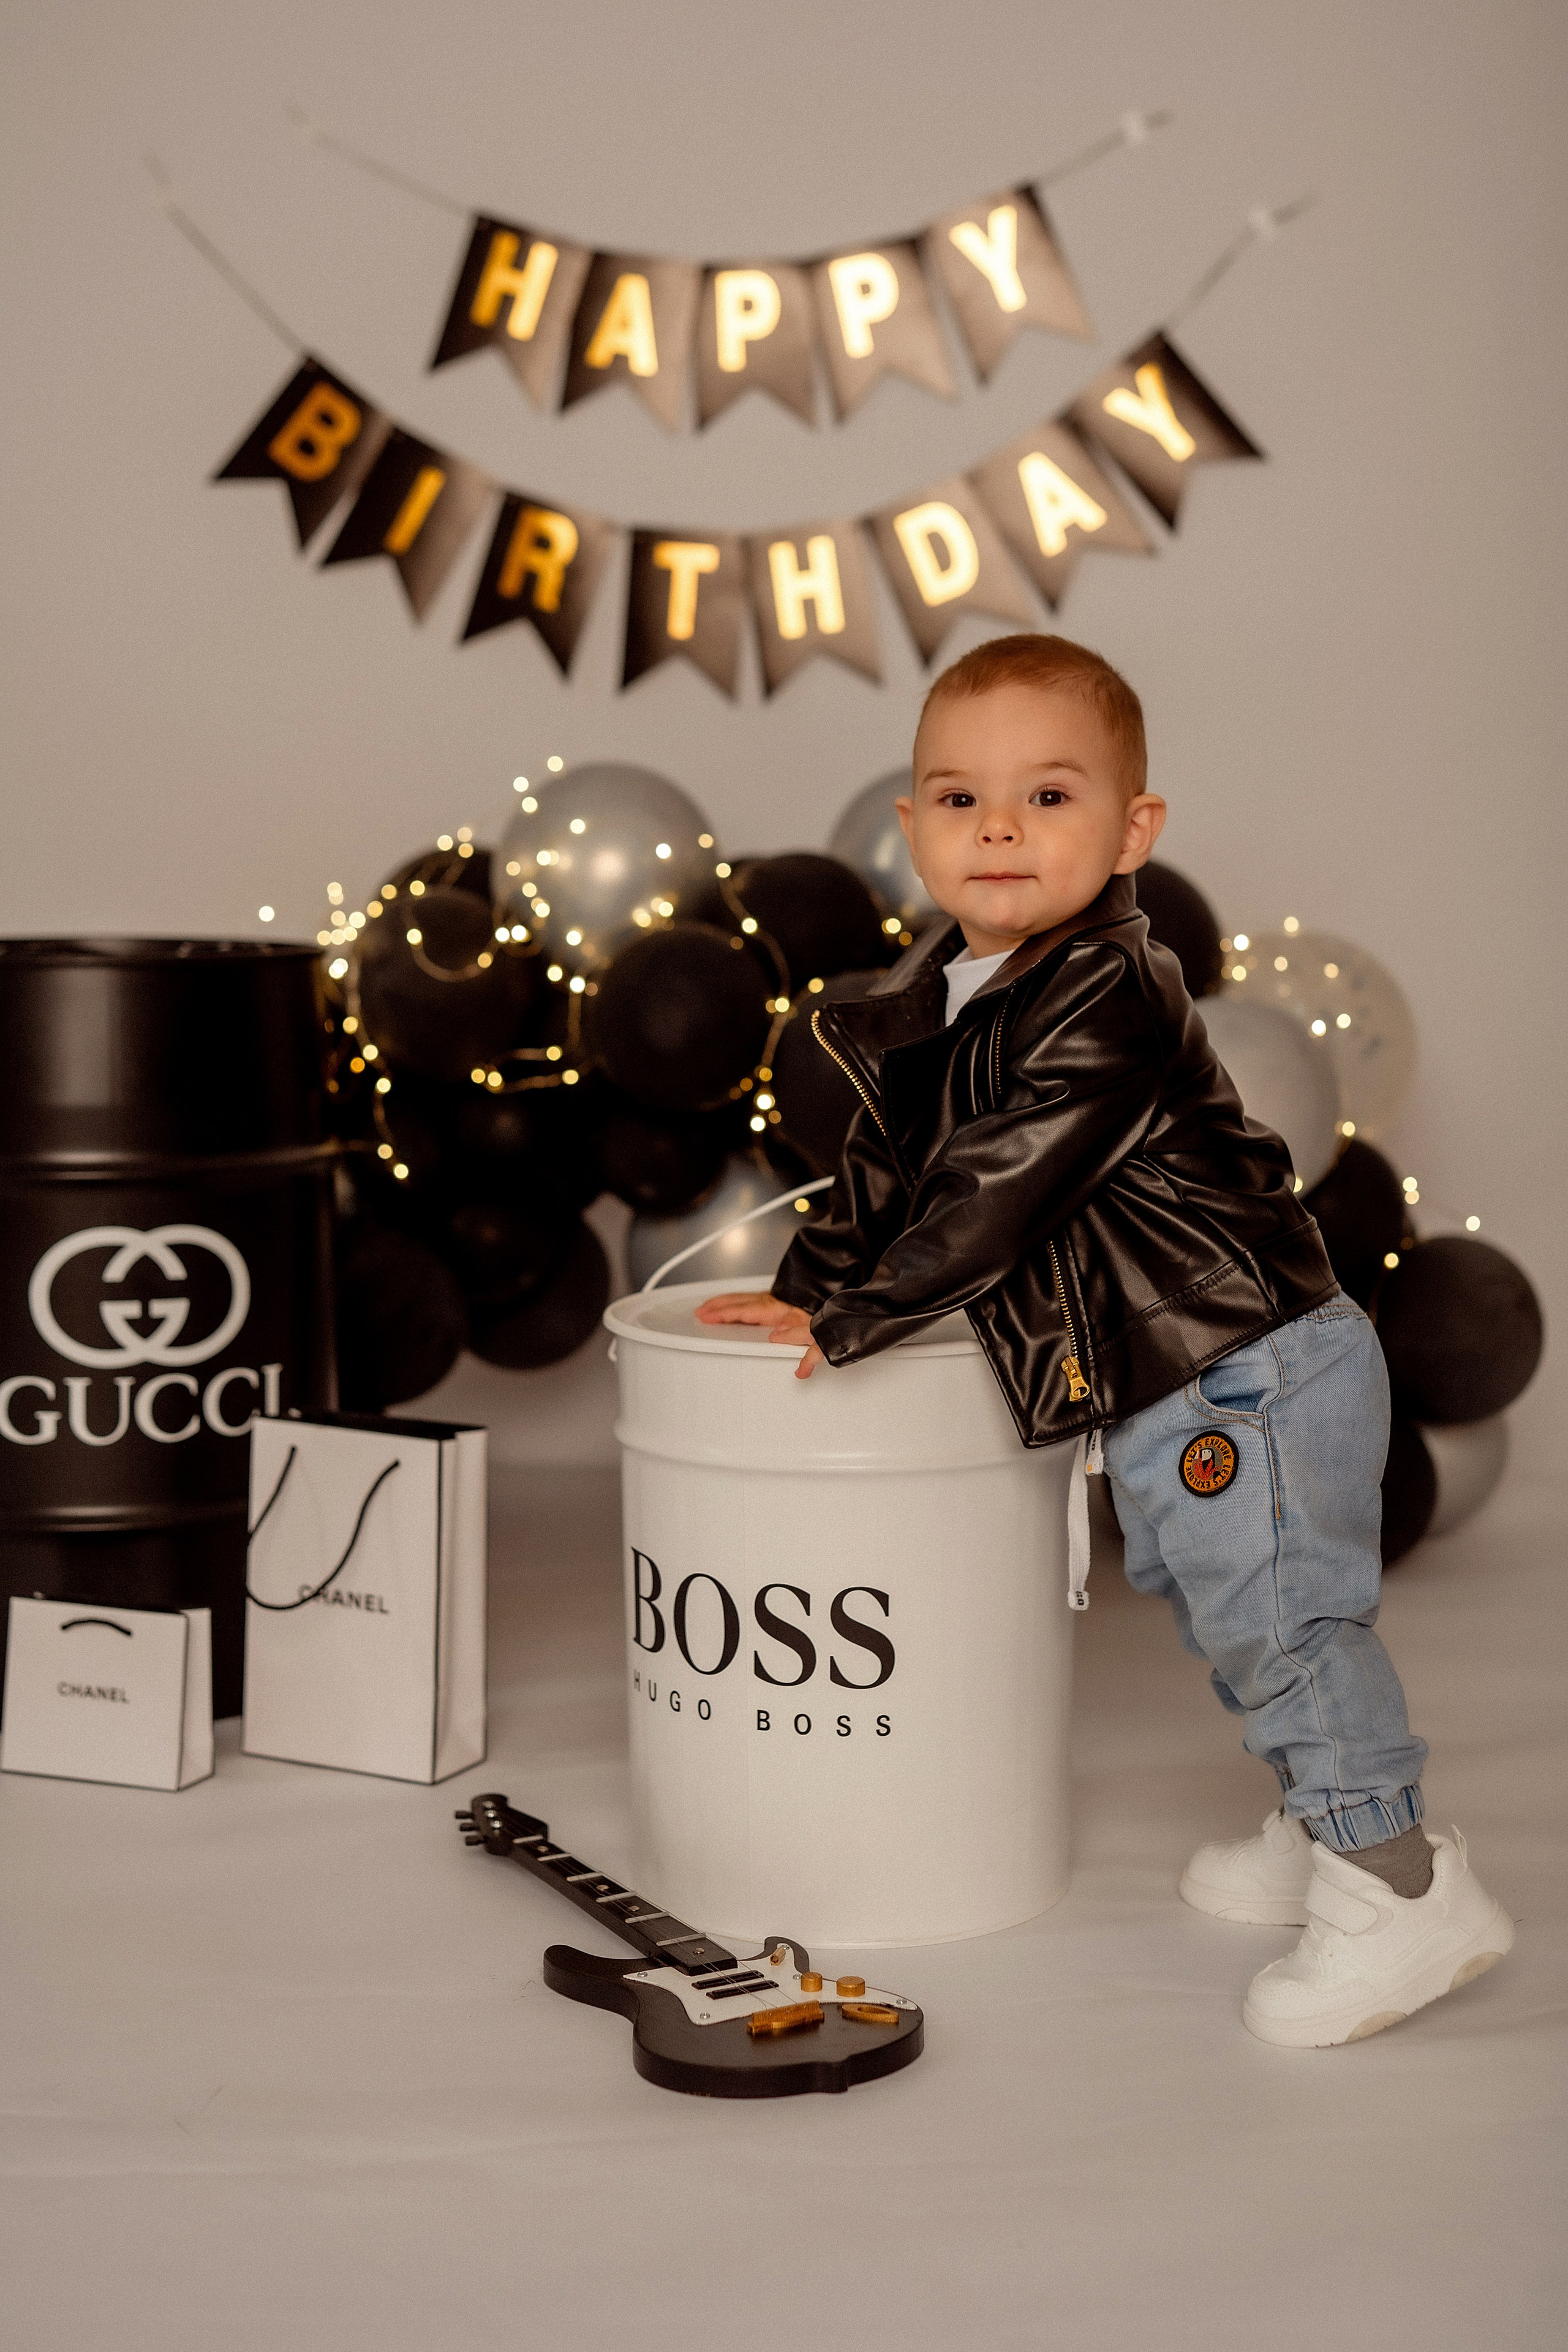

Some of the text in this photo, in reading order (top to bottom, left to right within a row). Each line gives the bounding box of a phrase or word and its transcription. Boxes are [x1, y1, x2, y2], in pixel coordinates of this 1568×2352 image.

[469, 204, 1027, 377] HAPPY
[267, 363, 1196, 639] BIRTHDAY
[0, 1363, 284, 1447] GUCCI
[1186, 1438, 1232, 1463] LET'S EXPLORE
[1186, 1464, 1231, 1489] LET'S EXPLORE
[631, 1547, 895, 1689] BOSS
[57, 1681, 129, 1703] CHANEL
[633, 1669, 891, 1737] HUGO BOSS
